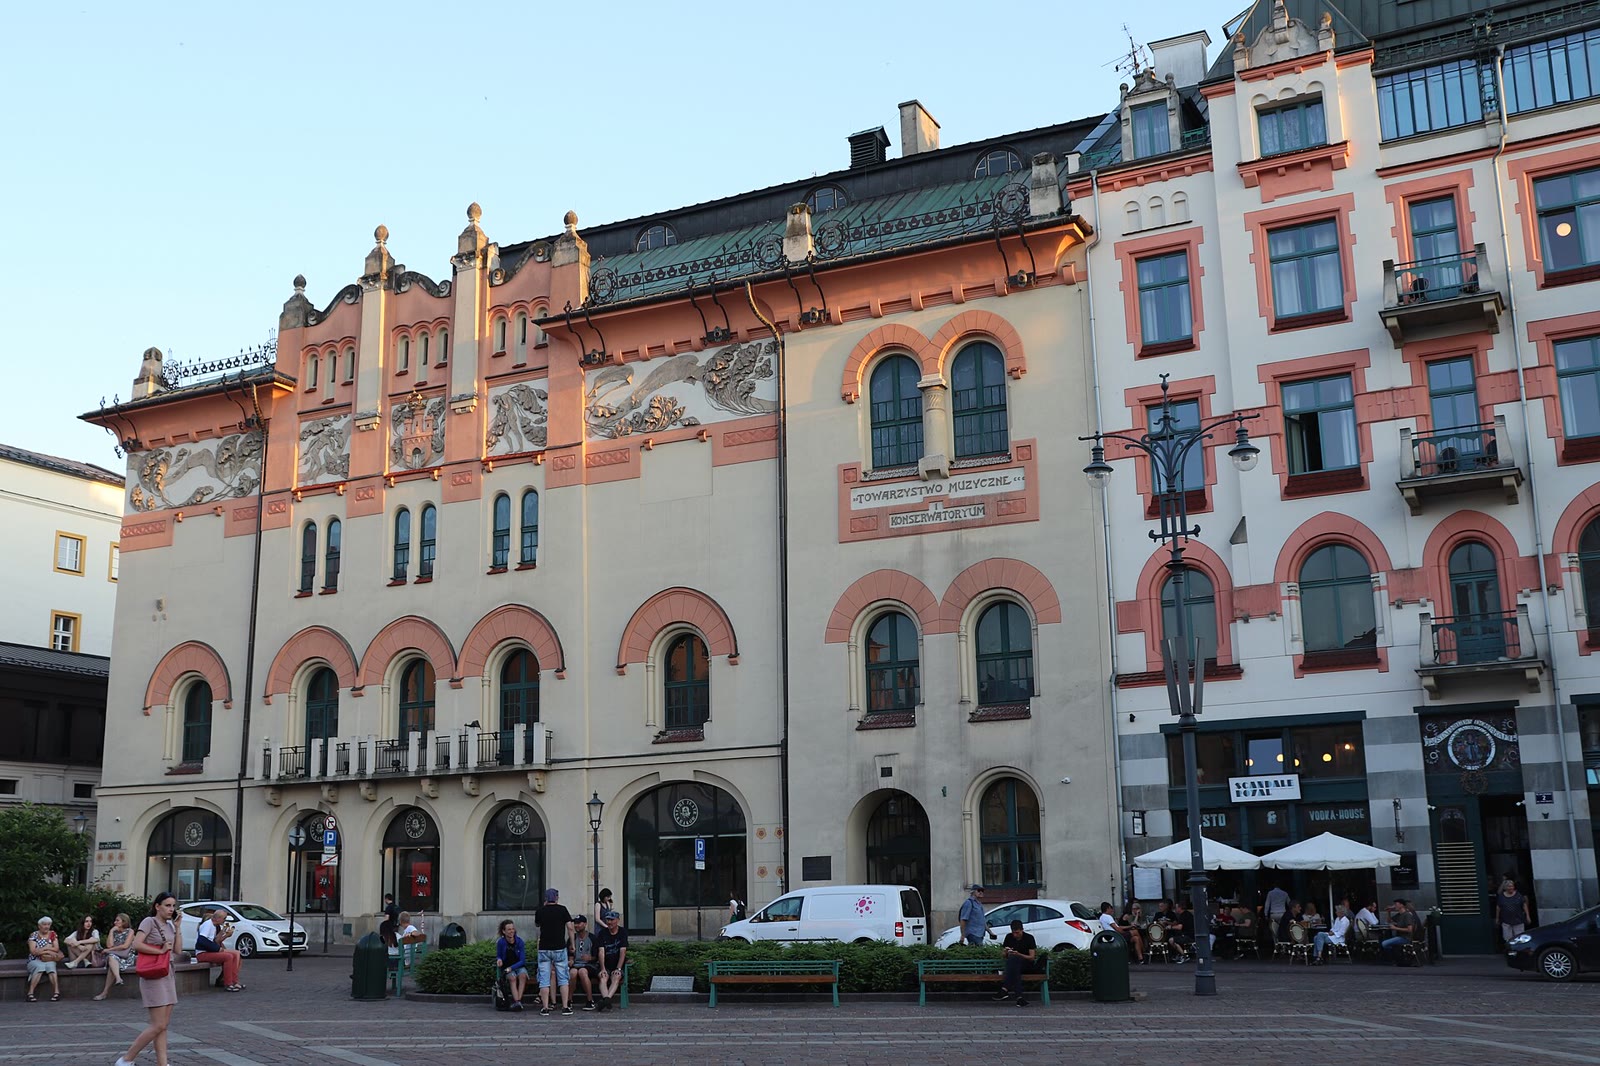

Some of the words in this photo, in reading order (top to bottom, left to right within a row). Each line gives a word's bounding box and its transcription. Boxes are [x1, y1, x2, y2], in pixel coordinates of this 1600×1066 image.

[891, 506, 986, 526] KONSERWATORYUM
[1235, 779, 1294, 789] SCANDALE
[1235, 789, 1272, 797] ROYAL
[1187, 813, 1227, 828] STO
[327, 832, 334, 844] P
[697, 841, 704, 854] P
